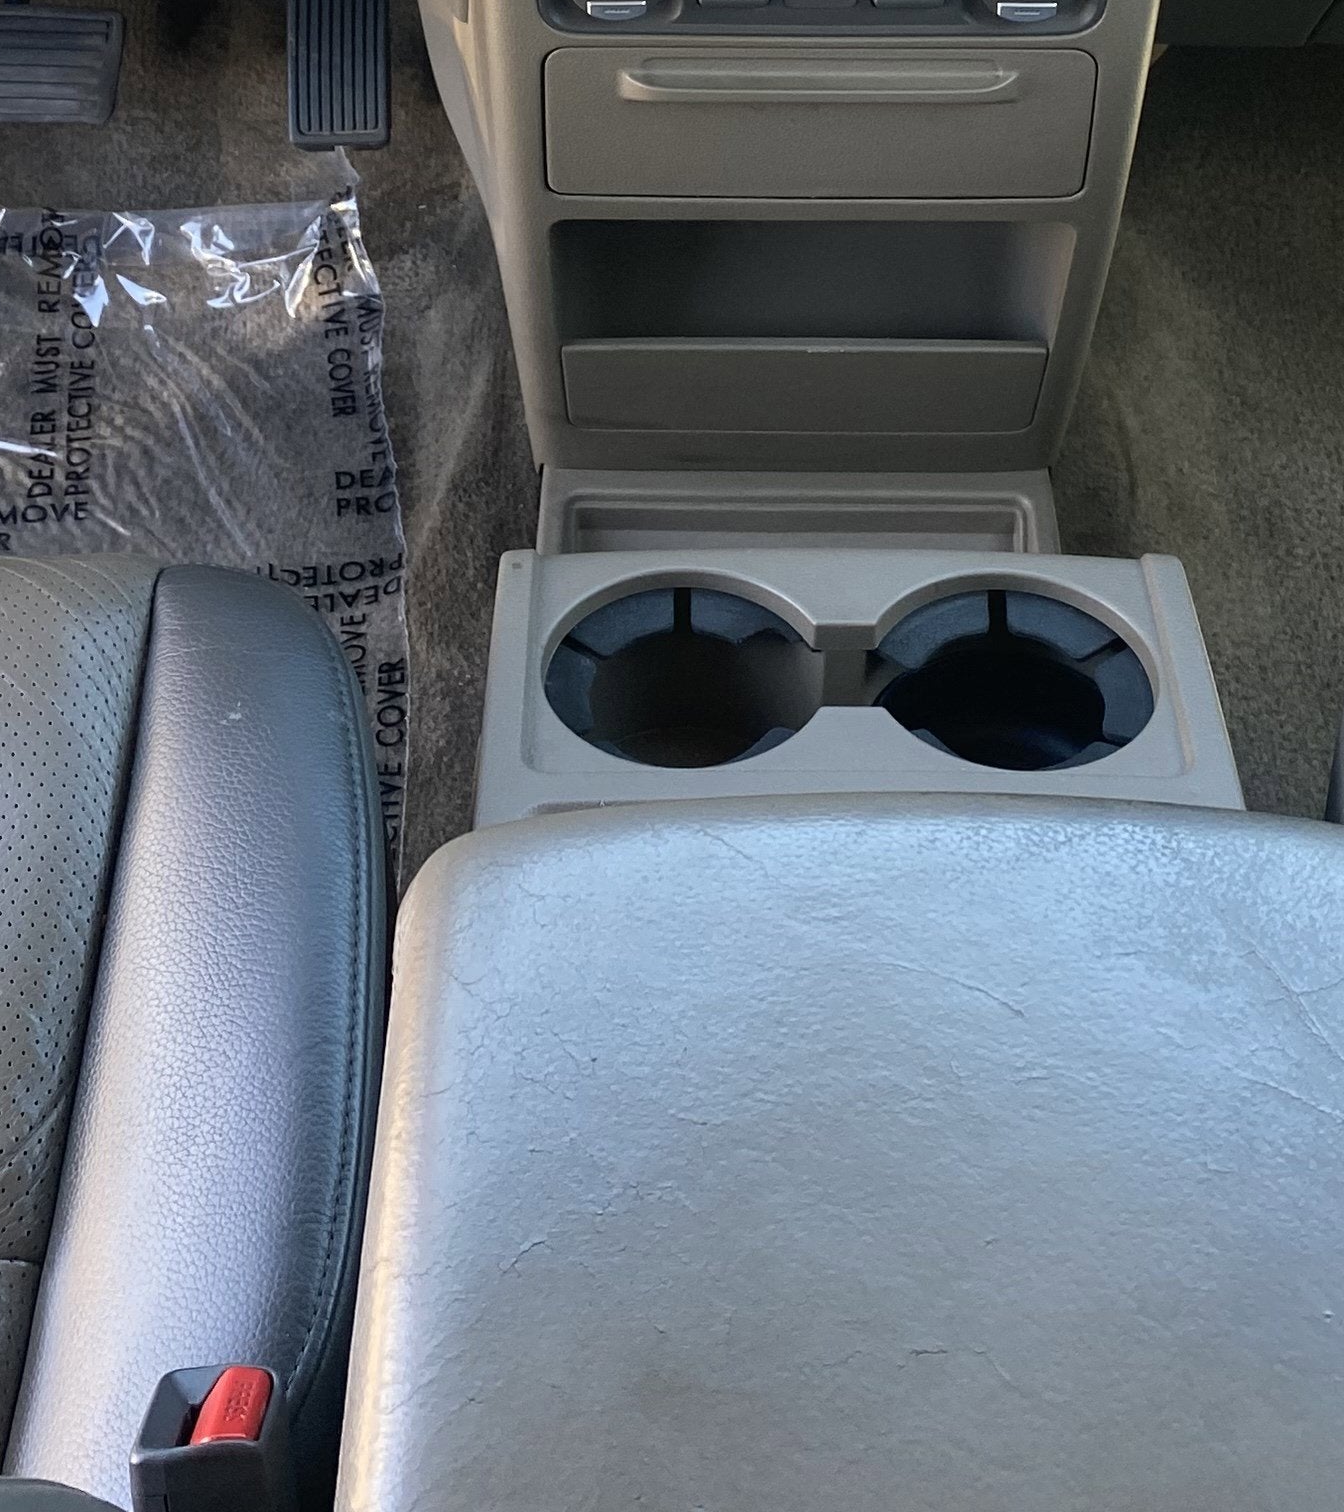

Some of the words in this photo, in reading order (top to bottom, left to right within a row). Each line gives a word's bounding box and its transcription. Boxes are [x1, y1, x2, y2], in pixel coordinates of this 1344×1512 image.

[32, 334, 62, 394] MUST
[355, 297, 383, 356] MUST
[326, 348, 357, 418] COVER
[27, 409, 56, 507] DEALER
[64, 360, 96, 497] PROTECTIVE
[375, 657, 407, 748] COVER
